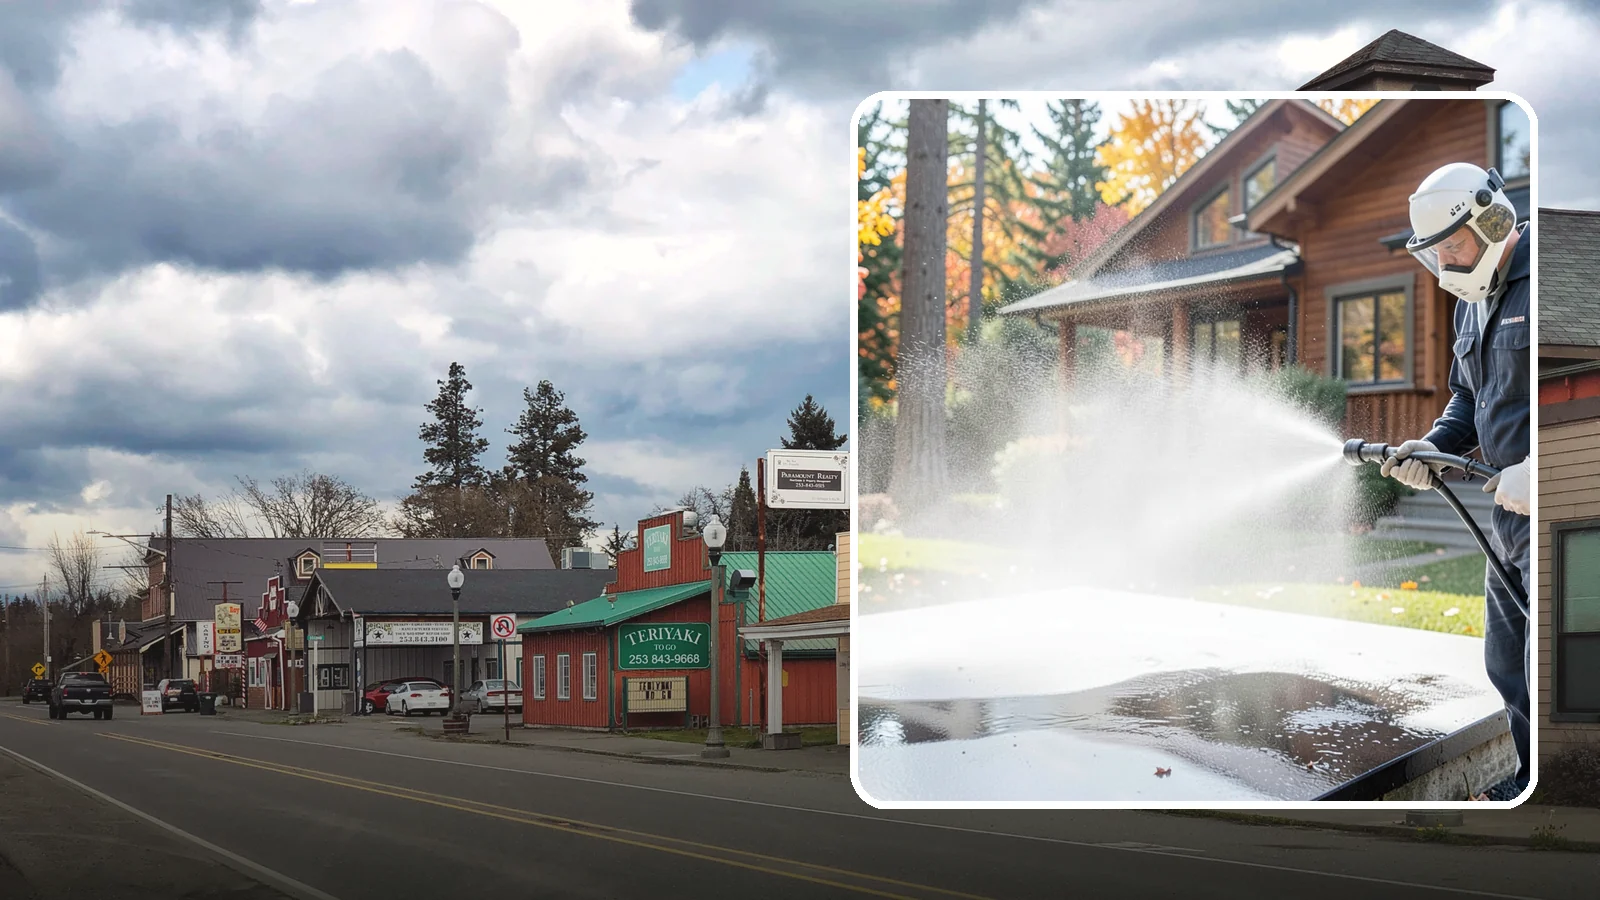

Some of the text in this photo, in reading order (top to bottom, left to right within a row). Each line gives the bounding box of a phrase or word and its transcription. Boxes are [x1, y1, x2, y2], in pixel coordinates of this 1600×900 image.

[624, 627, 702, 646] TERIYAKI
[665, 643, 677, 651] GO
[628, 653, 700, 665] 253 843-9668
[639, 681, 672, 690] TERIYAKI
